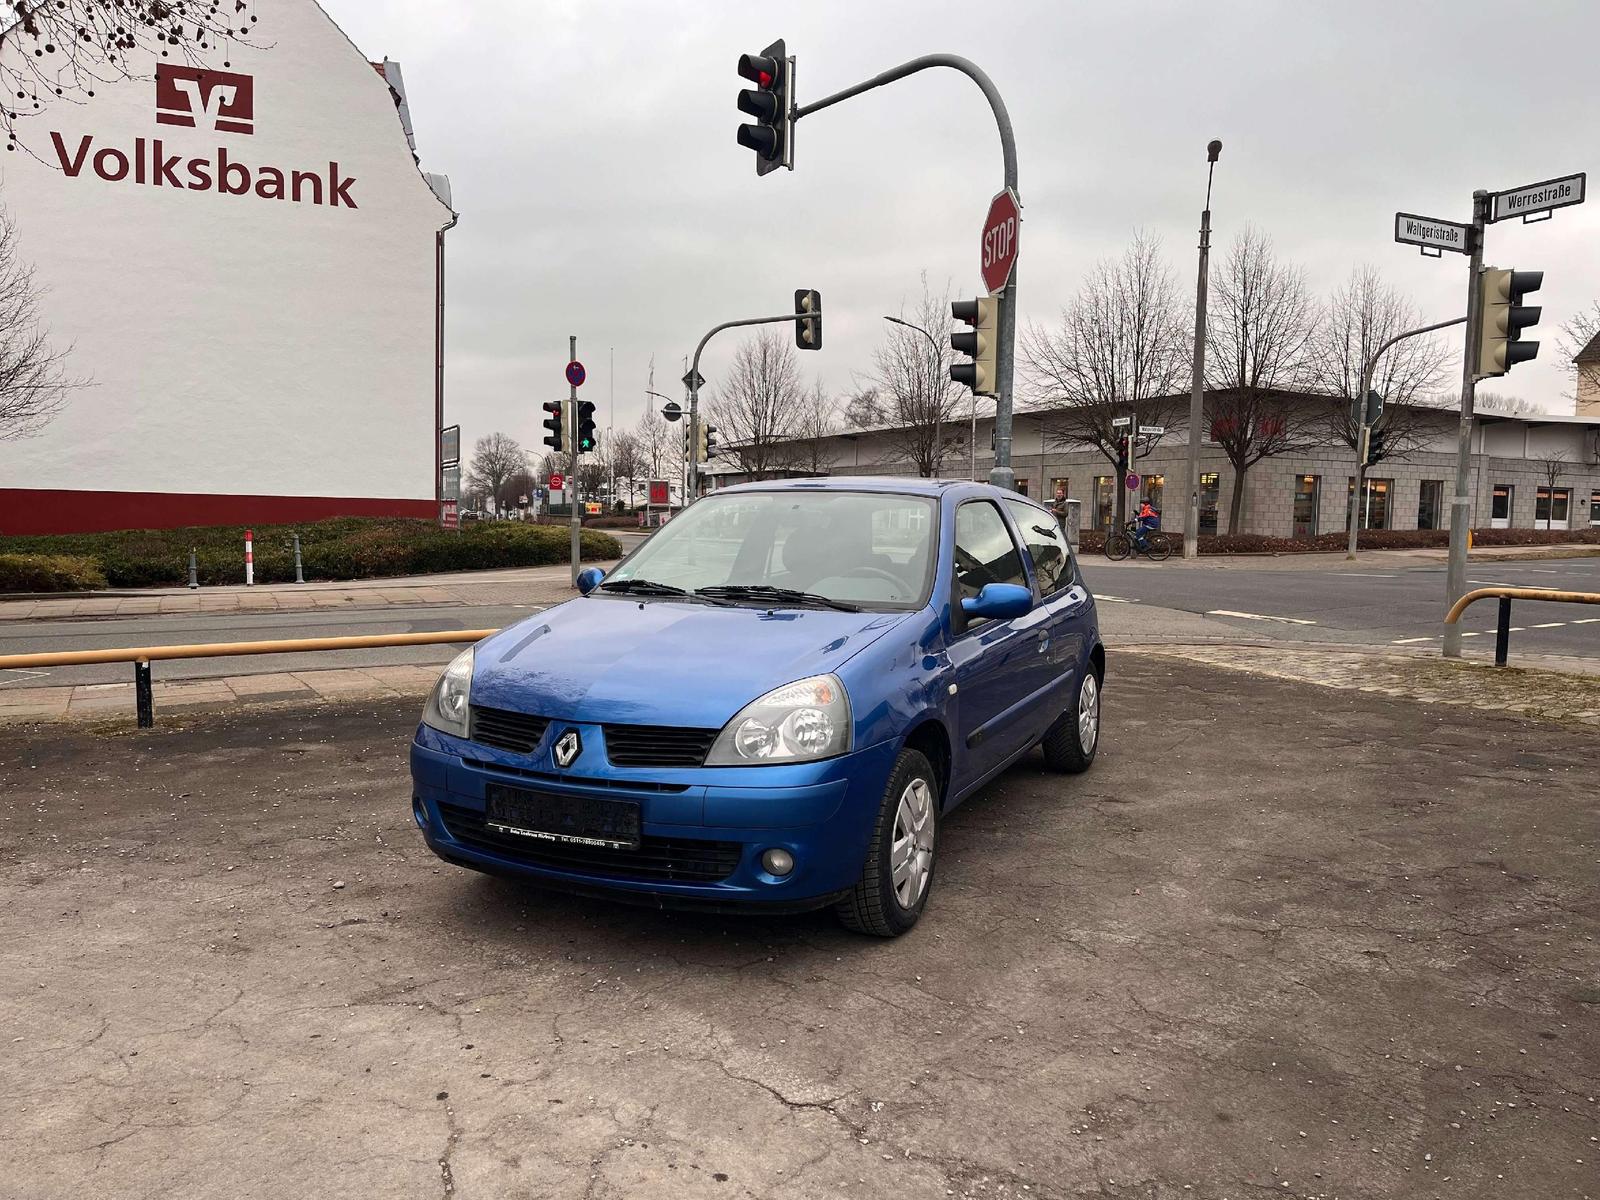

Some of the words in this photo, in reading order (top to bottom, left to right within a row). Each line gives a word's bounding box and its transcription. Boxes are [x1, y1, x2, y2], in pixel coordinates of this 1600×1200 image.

[50, 131, 358, 210] Volksbank
[1507, 184, 1571, 210] Werrestraße
[984, 217, 1014, 268] STOP
[1406, 220, 1459, 243] Waltgeristraße
